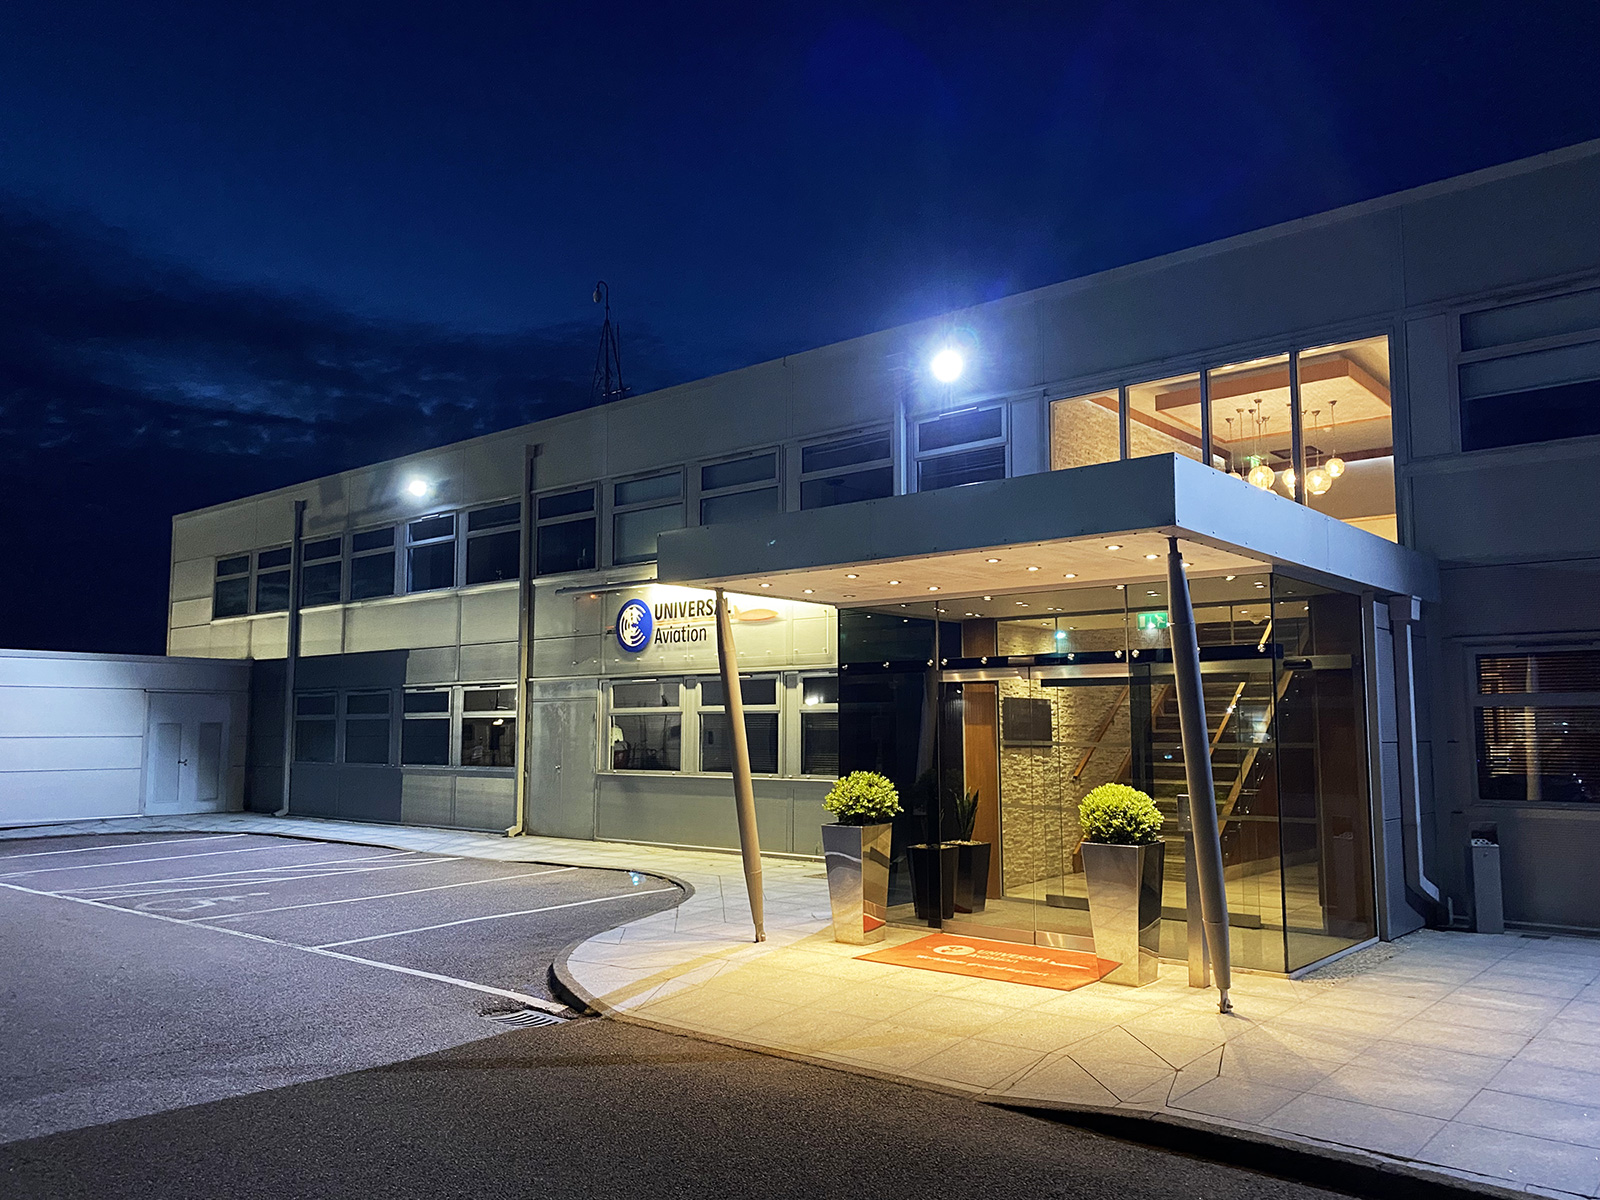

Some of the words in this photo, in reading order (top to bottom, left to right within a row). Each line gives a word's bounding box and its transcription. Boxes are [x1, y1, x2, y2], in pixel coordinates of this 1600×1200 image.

[654, 597, 731, 620] UNIVERS
[654, 624, 707, 644] Aviation
[976, 949, 1051, 963] UNIVERSAL
